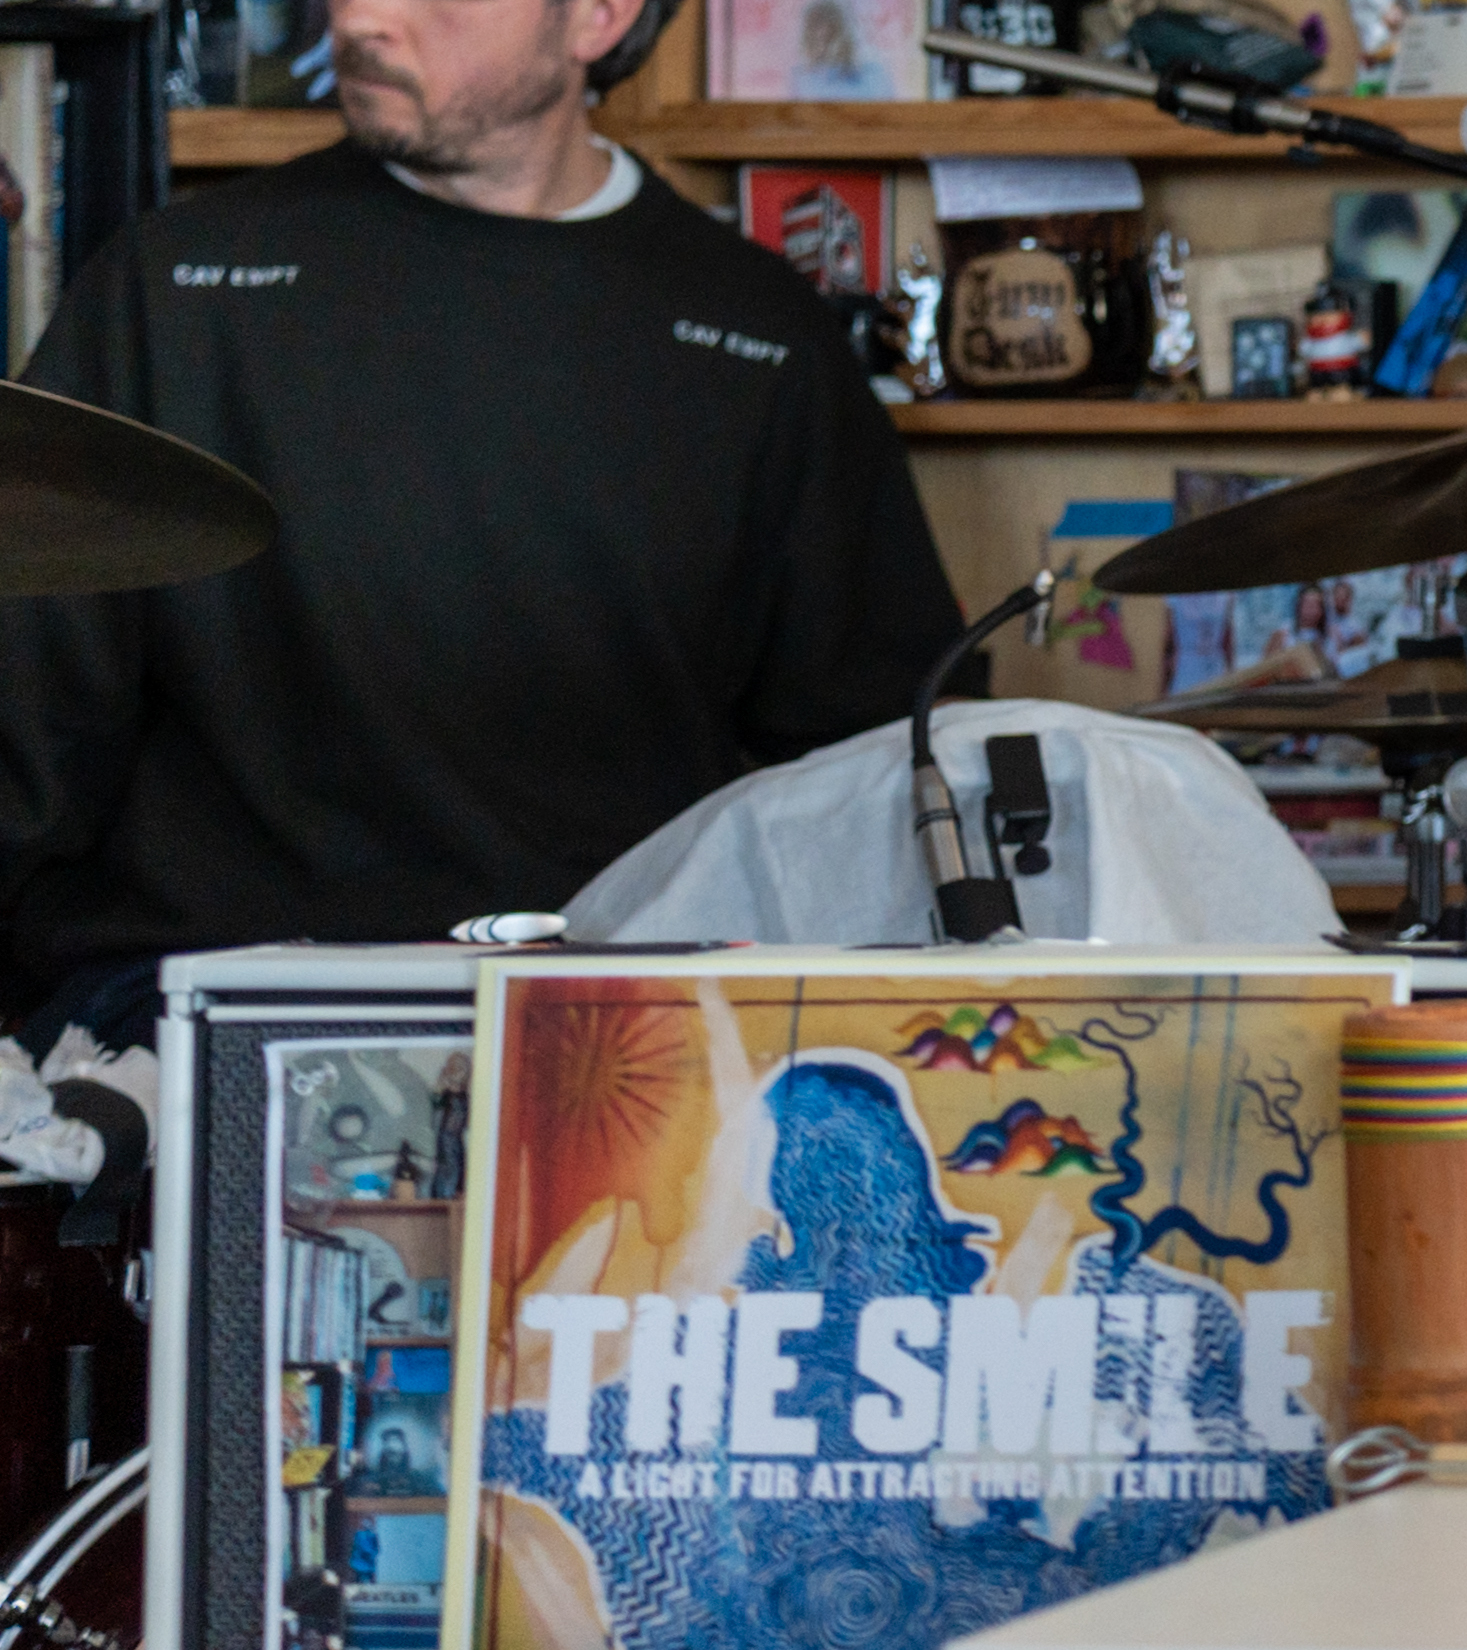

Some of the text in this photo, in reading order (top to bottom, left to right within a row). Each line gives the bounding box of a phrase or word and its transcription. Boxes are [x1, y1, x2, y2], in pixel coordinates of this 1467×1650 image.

[174, 264, 302, 288] CAV EMPT
[673, 318, 791, 367] CAV EMPT
[521, 1288, 1336, 1458] THE SMILE
[576, 1458, 1267, 1500] A LIGHT FOR ATTRACTING ATTENTION
